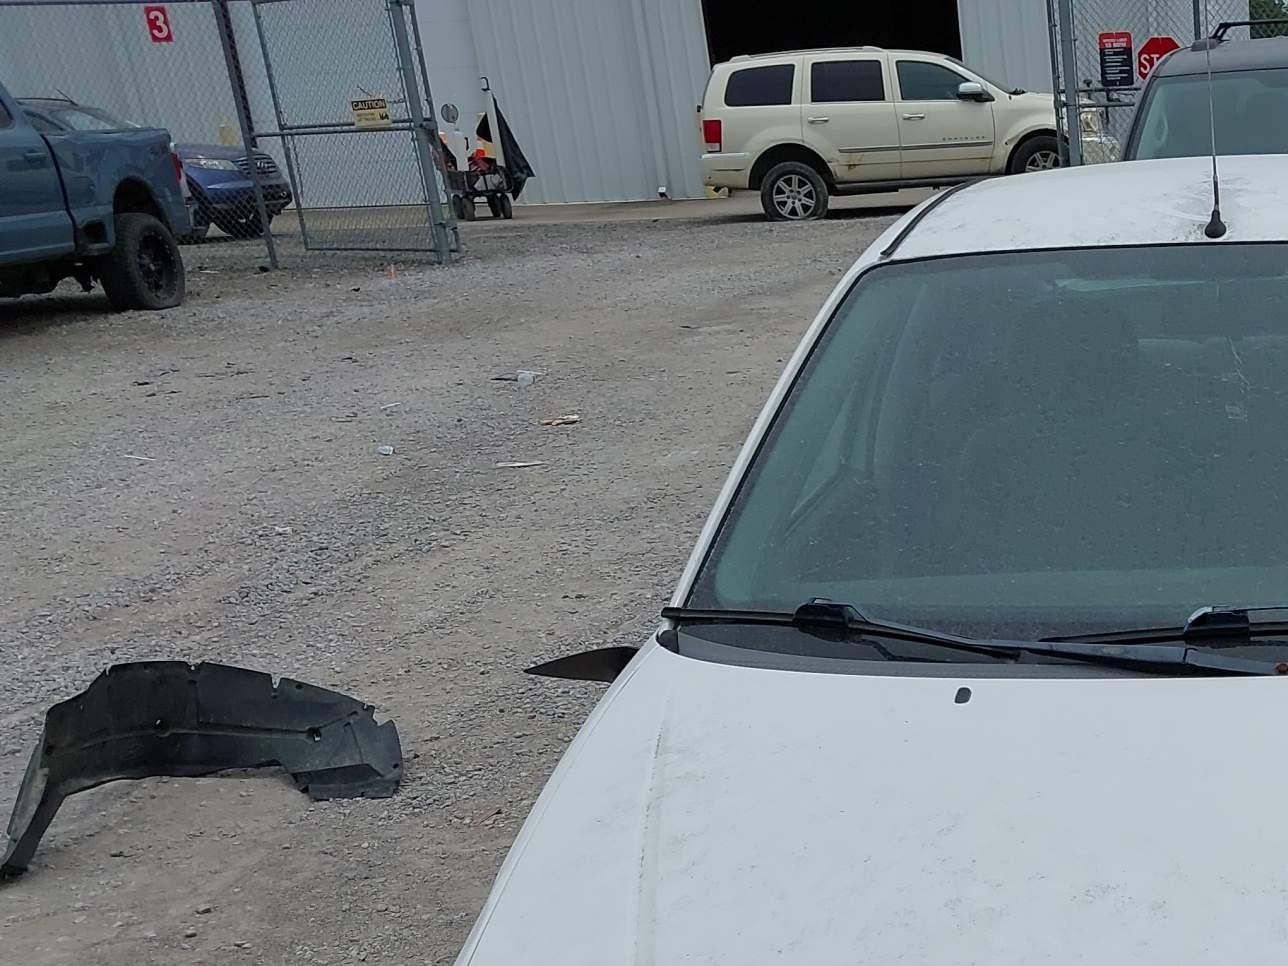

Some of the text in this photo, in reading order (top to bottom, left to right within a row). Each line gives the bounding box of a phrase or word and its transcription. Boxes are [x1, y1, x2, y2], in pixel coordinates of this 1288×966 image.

[149, 11, 168, 38] 3
[1140, 54, 1160, 74] ST
[353, 101, 385, 110] CAUTION
